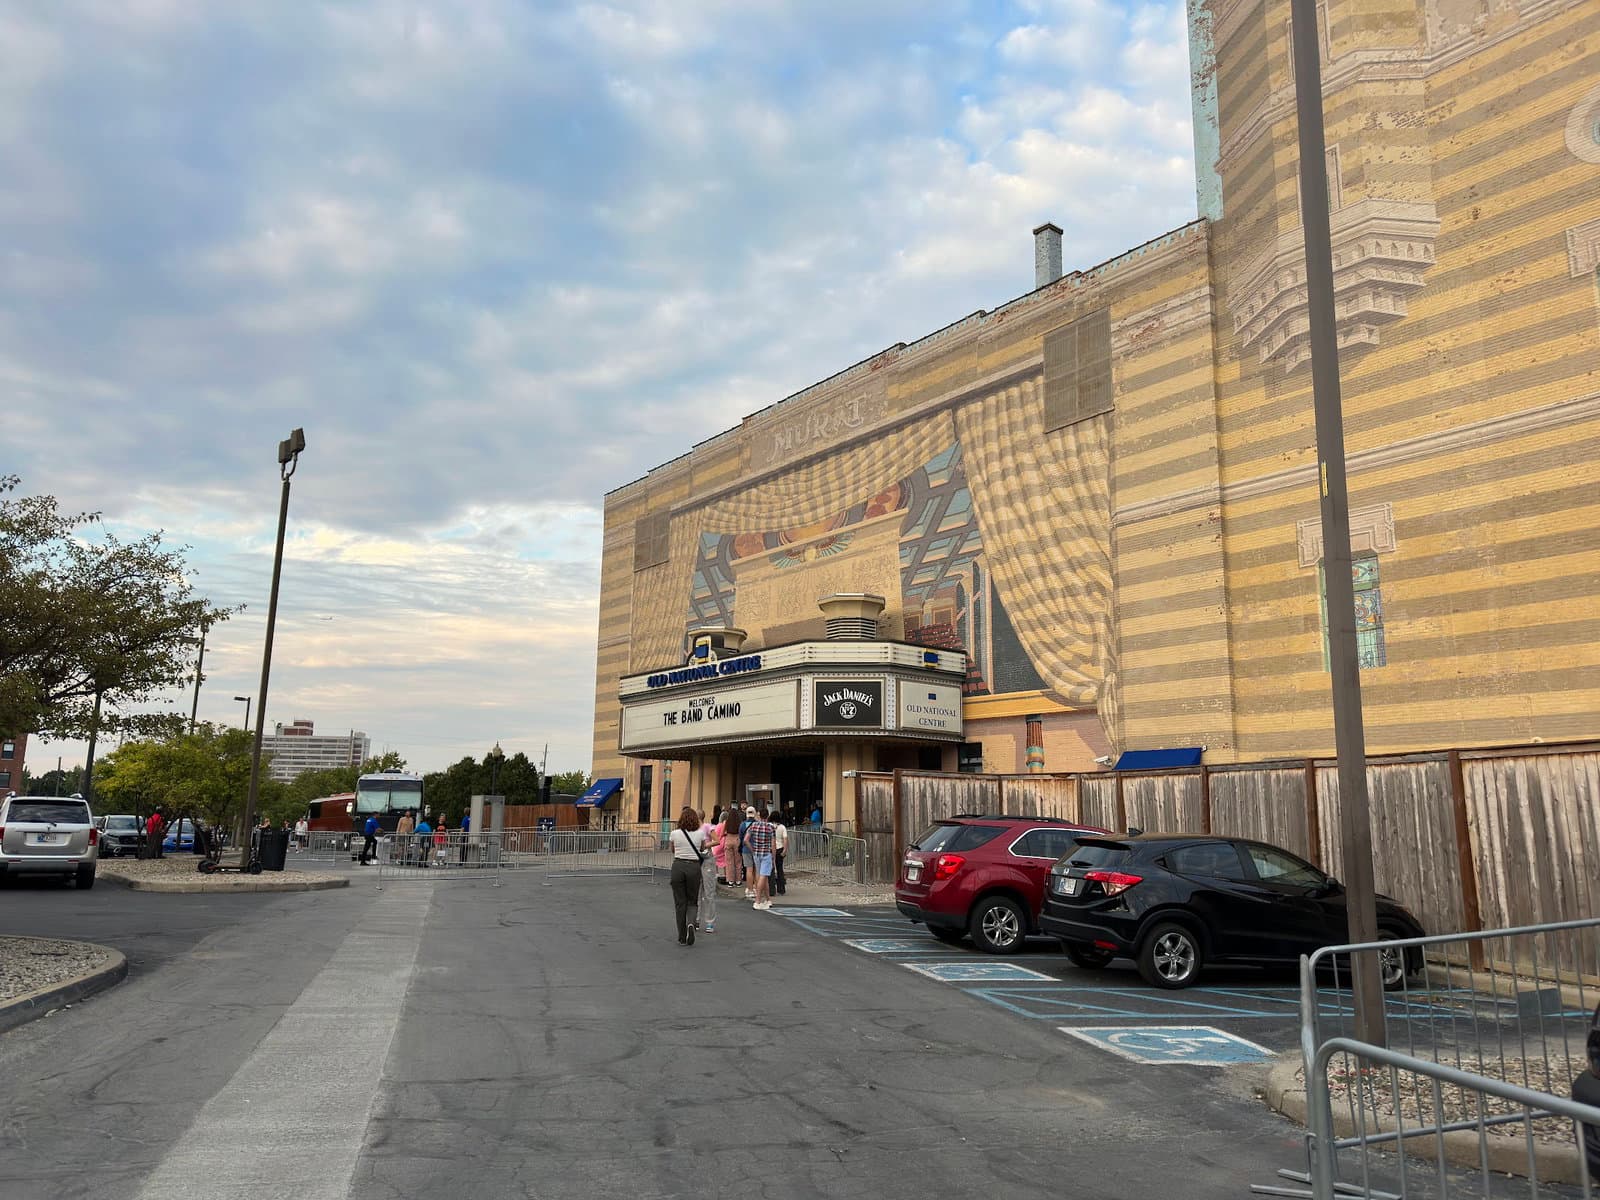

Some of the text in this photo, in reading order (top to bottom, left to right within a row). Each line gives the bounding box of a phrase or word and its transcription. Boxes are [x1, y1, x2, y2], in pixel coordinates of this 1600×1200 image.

[647, 655, 762, 688] OLD NATIONAL CENTRE
[823, 690, 842, 707] JACK
[663, 702, 741, 726] THE BAND CAMINO
[906, 704, 957, 717] OLD NATIONAL
[918, 717, 947, 728] CENTRE
